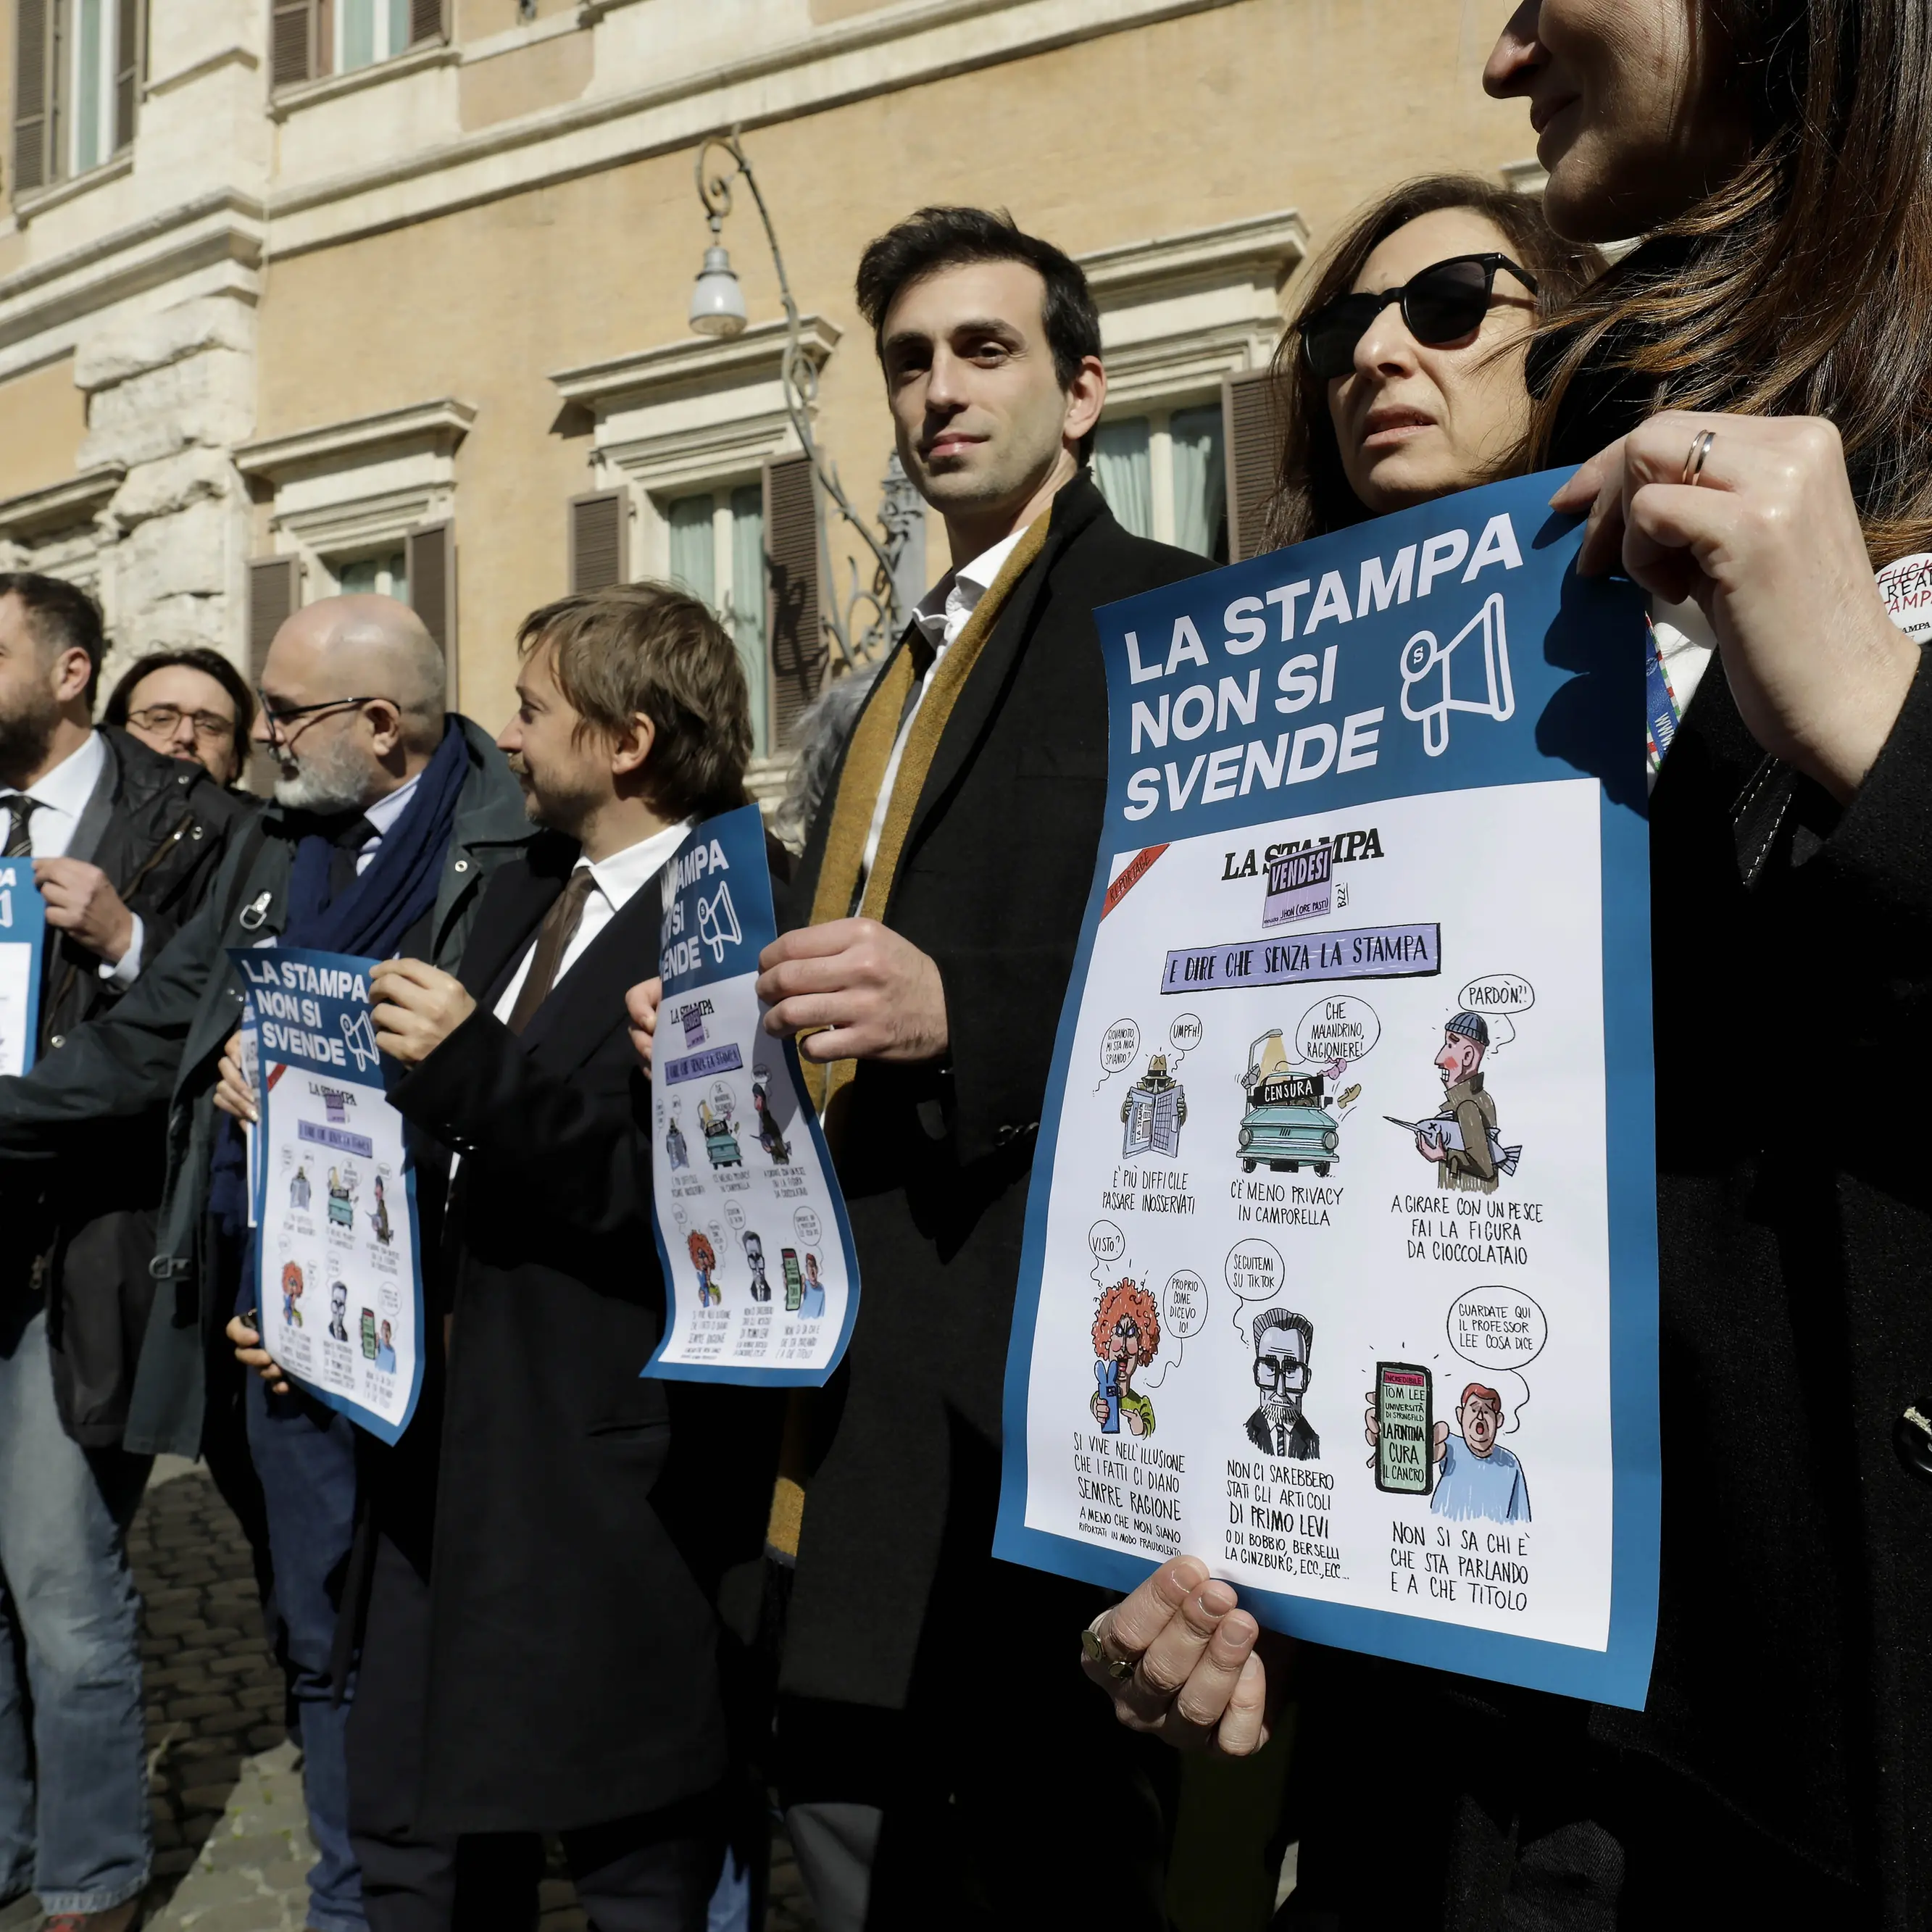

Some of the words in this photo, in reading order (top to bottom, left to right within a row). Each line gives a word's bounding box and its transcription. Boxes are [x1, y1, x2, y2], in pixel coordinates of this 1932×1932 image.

[1887, 569, 1932, 601] REA
[1125, 616, 1209, 684] LA
[1224, 512, 1523, 655] STAMPA
[1902, 622, 1931, 634] AMPA
[1131, 669, 1260, 754] NON
[1275, 645, 1338, 714] SI
[1123, 707, 1385, 822] SVENDE
[676, 838, 729, 892] AMPA
[1221, 849, 1258, 880] LA
[1270, 851, 1329, 892] VENDESI
[1109, 851, 1150, 903] REPORTAGE
[1280, 906, 1295, 919] JHON
[1296, 904, 1311, 915] (ORE
[1312, 897, 1329, 910] PASTI)
[662, 936, 701, 983] ENDE
[1169, 961, 1178, 983] E
[1185, 955, 1217, 981] DIRE
[1225, 949, 1254, 978] CHE
[1265, 944, 1310, 973] SENZA
[1320, 943, 1342, 969] LA
[1352, 935, 1428, 963] STAMPA
[241, 959, 280, 986] LA
[280, 962, 370, 1004] STAMPA
[255, 989, 300, 1023] NON
[301, 999, 322, 1028] SI
[1325, 1002, 1346, 1020] CHE
[1173, 1023, 1200, 1038] UMPFH!
[1312, 1023, 1364, 1042] MALANDRINO,
[262, 1021, 346, 1067] SVENDE
[1307, 1041, 1363, 1058] RAGIONIERE!
[1264, 1082, 1313, 1102] CENSURA
[1123, 1166, 1138, 1188] PIÙ
[1142, 1170, 1188, 1190] DIFFICILE
[1102, 1192, 1135, 1211] PASSARE
[1142, 1194, 1195, 1215] INOSSERVATI
[1247, 1185, 1285, 1203] MENO
[1292, 1186, 1344, 1205] PRIVACY
[1238, 1206, 1251, 1222] IN
[1255, 1208, 1331, 1226] CAMPORELLA
[1391, 1195, 1402, 1213] A
[1405, 1195, 1450, 1214] GIRARE
[1457, 1198, 1481, 1217] CON
[1487, 1201, 1504, 1218] UN
[1509, 1203, 1543, 1223] PESCE
[1412, 1219, 1431, 1236] FAI
[1441, 1220, 1458, 1239] LA
[1470, 1221, 1522, 1241] FIGURA
[1092, 1236, 1120, 1253] VISTO?
[1407, 1240, 1425, 1259] DA
[1433, 1241, 1528, 1265] CIOCCOLATAIO
[1233, 1254, 1274, 1272] SEGUITEMI
[1172, 1278, 1199, 1292] PROPRIO
[1233, 1273, 1244, 1288] SU
[1173, 1291, 1191, 1304] COME
[1170, 1305, 1196, 1319] DICEVO
[1459, 1304, 1509, 1318] GUARDATE
[1515, 1306, 1531, 1319] QUI
[1178, 1323, 1188, 1333] IO!
[1460, 1319, 1467, 1331] IL
[1473, 1320, 1529, 1333] PROFESSOR
[1460, 1333, 1478, 1348] LEE
[1486, 1334, 1511, 1349] COSA
[1515, 1337, 1533, 1350] DICE
[1385, 1373, 1422, 1385] INCREDIBILE
[1383, 1385, 1404, 1399] TOM
[1409, 1389, 1425, 1401] LEE
[1383, 1423, 1393, 1439] LA
[1074, 1432, 1083, 1451] SI
[1089, 1435, 1109, 1456] VIVE
[1389, 1442, 1419, 1465] CURA
[1074, 1454, 1092, 1473] CHE
[1096, 1459, 1101, 1475] I
[1103, 1460, 1128, 1481] FATTI
[1133, 1467, 1144, 1486] CI
[1149, 1472, 1180, 1494] DIANO
[1227, 1460, 1250, 1480] NON
[1253, 1465, 1265, 1481] CI
[1270, 1465, 1334, 1490] SAREBBERO
[1383, 1464, 1389, 1478] IL
[1392, 1465, 1424, 1483] CANCRO
[1078, 1477, 1123, 1508] SEMPRE
[1130, 1489, 1181, 1520] RAGIONE
[1226, 1479, 1249, 1499] STATI
[1254, 1486, 1271, 1504] GLI
[1279, 1490, 1331, 1510] ARTICOLI
[1079, 1507, 1086, 1519] A
[1088, 1510, 1112, 1525] MENO
[1114, 1515, 1129, 1530] CHE
[1134, 1520, 1152, 1536] NON
[1156, 1524, 1181, 1544] SIANO
[1229, 1500, 1244, 1524] DI
[1251, 1504, 1294, 1533] PRIMO
[1300, 1512, 1329, 1539] LEVI
[1078, 1521, 1107, 1538] RIPORTATI
[1111, 1530, 1118, 1540] IN
[1120, 1533, 1137, 1546] MODO
[1225, 1529, 1231, 1543] O
[1234, 1531, 1244, 1545] DI
[1293, 1540, 1340, 1560] BERSELLI
[1393, 1521, 1425, 1546] NON
[1437, 1526, 1450, 1547] SI
[1461, 1530, 1478, 1551] SA
[1487, 1534, 1510, 1554] CHI
[1225, 1546, 1238, 1561] LA
[1391, 1548, 1415, 1569] CHE
[1425, 1552, 1449, 1575] STA
[1458, 1556, 1528, 1584] PARLANDO
[1391, 1572, 1398, 1592] E
[1407, 1574, 1418, 1594] A
[1431, 1577, 1457, 1601] CHE
[1467, 1583, 1528, 1611] TITOLO
